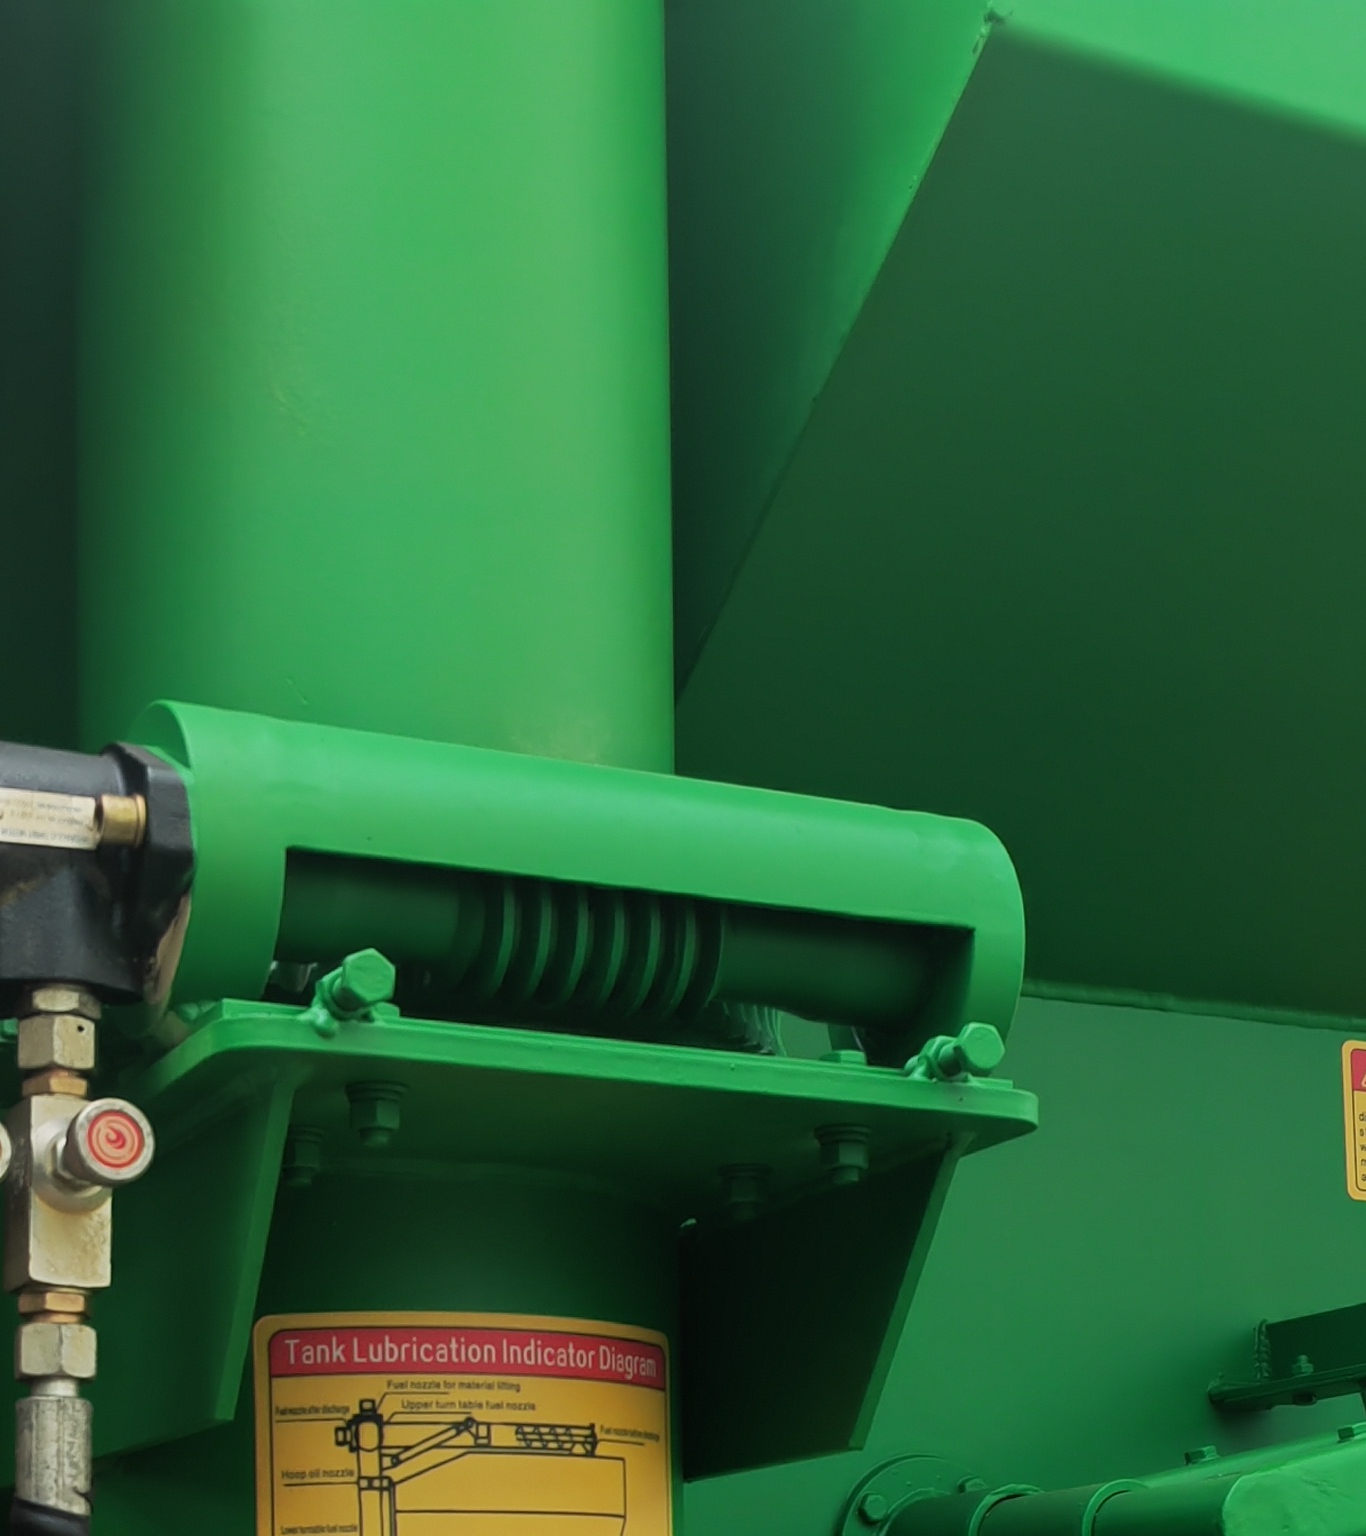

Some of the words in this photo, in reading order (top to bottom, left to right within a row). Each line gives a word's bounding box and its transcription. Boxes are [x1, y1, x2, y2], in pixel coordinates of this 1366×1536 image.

[285, 1336, 346, 1365] Tank
[353, 1335, 496, 1365] Lubrication
[502, 1339, 595, 1369] Indicator
[599, 1347, 657, 1379] Diagram
[387, 1380, 408, 1389] Fuel
[410, 1380, 440, 1389] nozzle
[443, 1380, 456, 1389] for
[458, 1380, 494, 1390] material
[401, 1399, 433, 1411] Upper
[436, 1400, 456, 1408] turn
[458, 1399, 483, 1409] table
[486, 1400, 503, 1409] fuel
[506, 1401, 537, 1411] nozzle
[322, 1468, 354, 1478] nozzle
